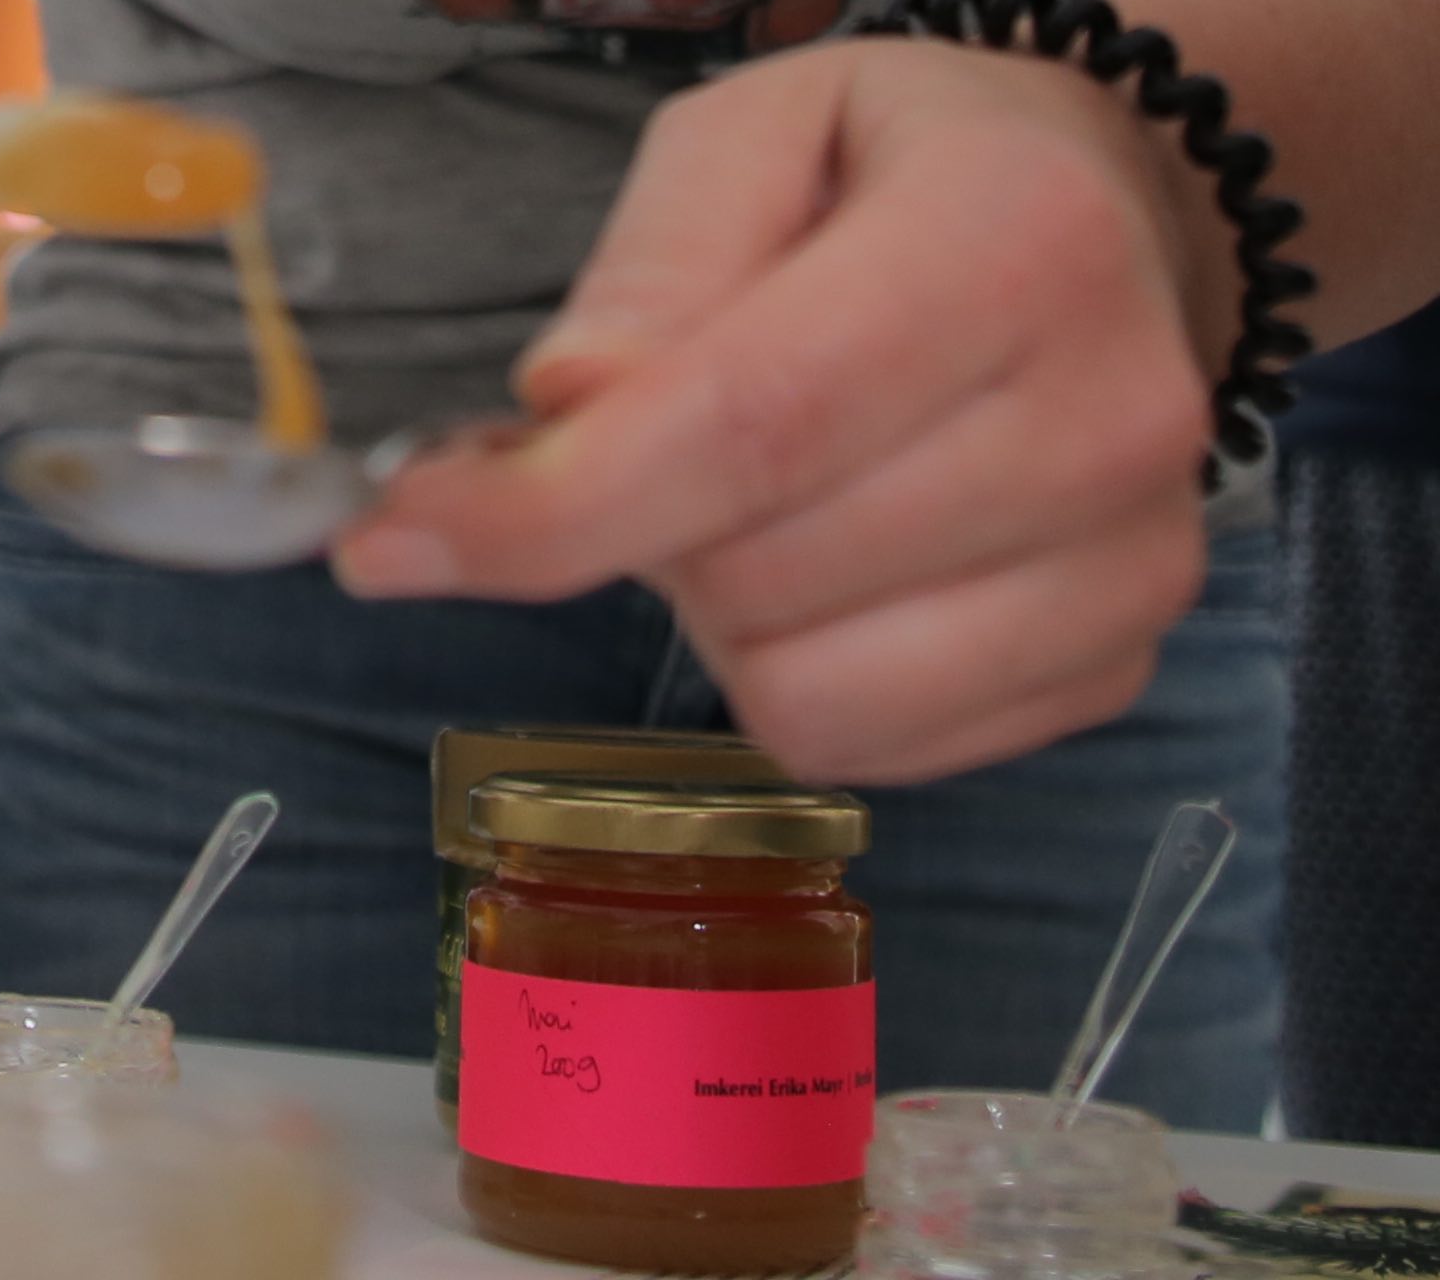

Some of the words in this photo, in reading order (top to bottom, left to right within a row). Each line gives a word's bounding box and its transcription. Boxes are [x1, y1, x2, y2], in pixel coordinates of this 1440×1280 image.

[535, 1043, 602, 1093] 200g
[694, 1076, 763, 1097] Imkerei
[769, 1077, 807, 1097] Erika
[812, 1076, 844, 1098] Mayr
